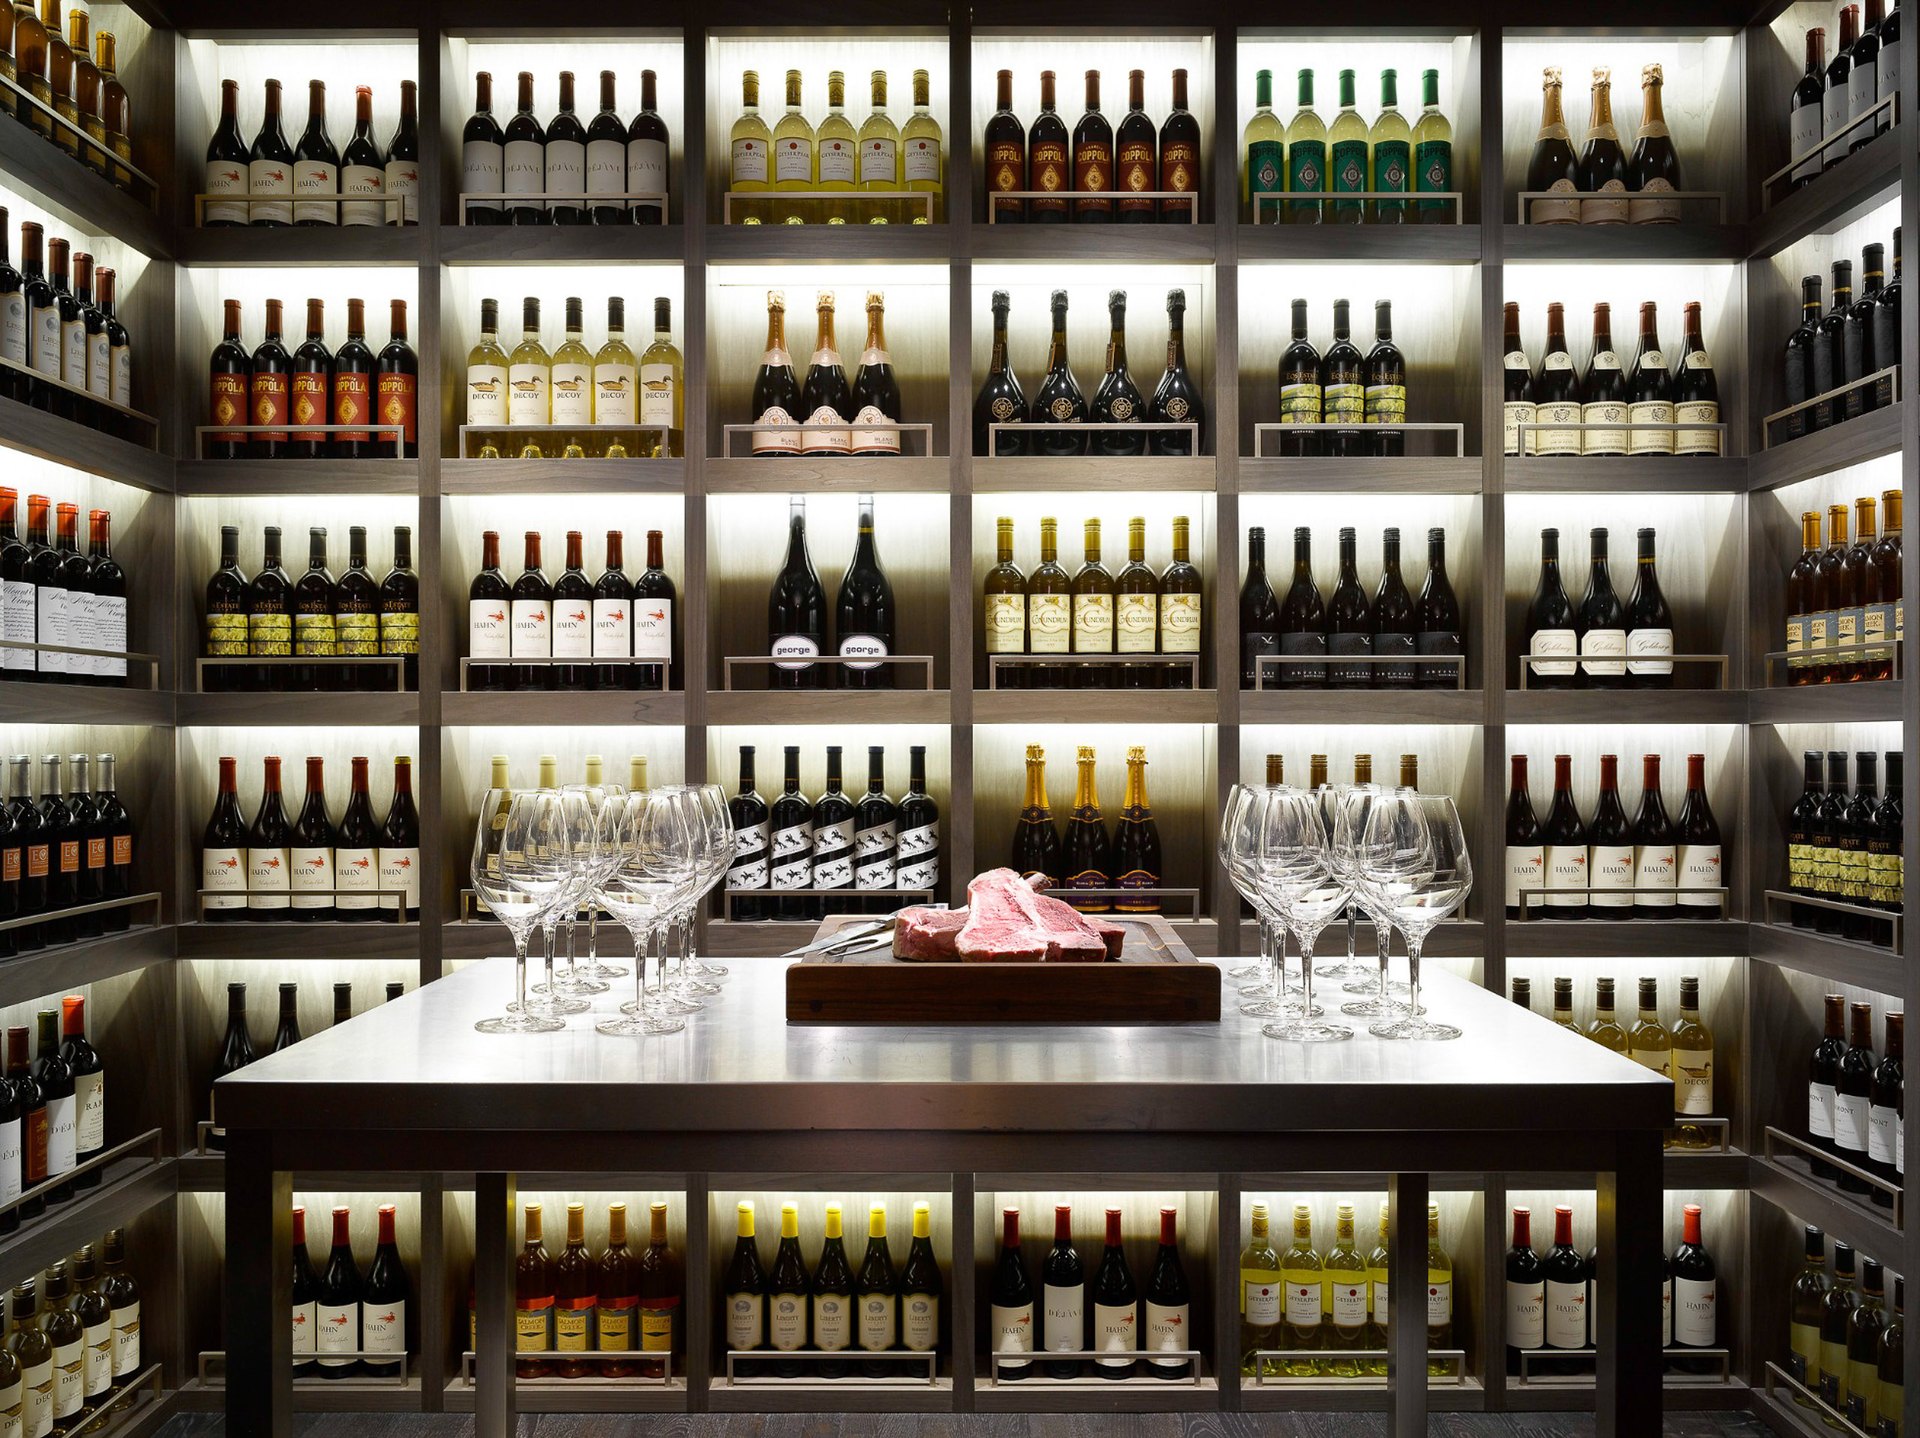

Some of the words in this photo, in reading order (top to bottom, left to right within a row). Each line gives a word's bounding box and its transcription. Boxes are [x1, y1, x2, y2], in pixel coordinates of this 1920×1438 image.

[474, 621, 496, 629] HAHN
[515, 621, 537, 629] HAHN
[556, 621, 577, 629] HAHN
[777, 646, 810, 655] george
[846, 646, 879, 655] george
[206, 868, 228, 876] HAHN
[1516, 1304, 1539, 1313] HAHN
[1556, 1304, 1580, 1313] HAHN
[1686, 1302, 1711, 1311] HAHN
[365, 1323, 386, 1332] HAHN
[1001, 1326, 1025, 1334] HAHN
[1106, 1325, 1129, 1333] HAHN
[1152, 1324, 1175, 1333] HAHN
